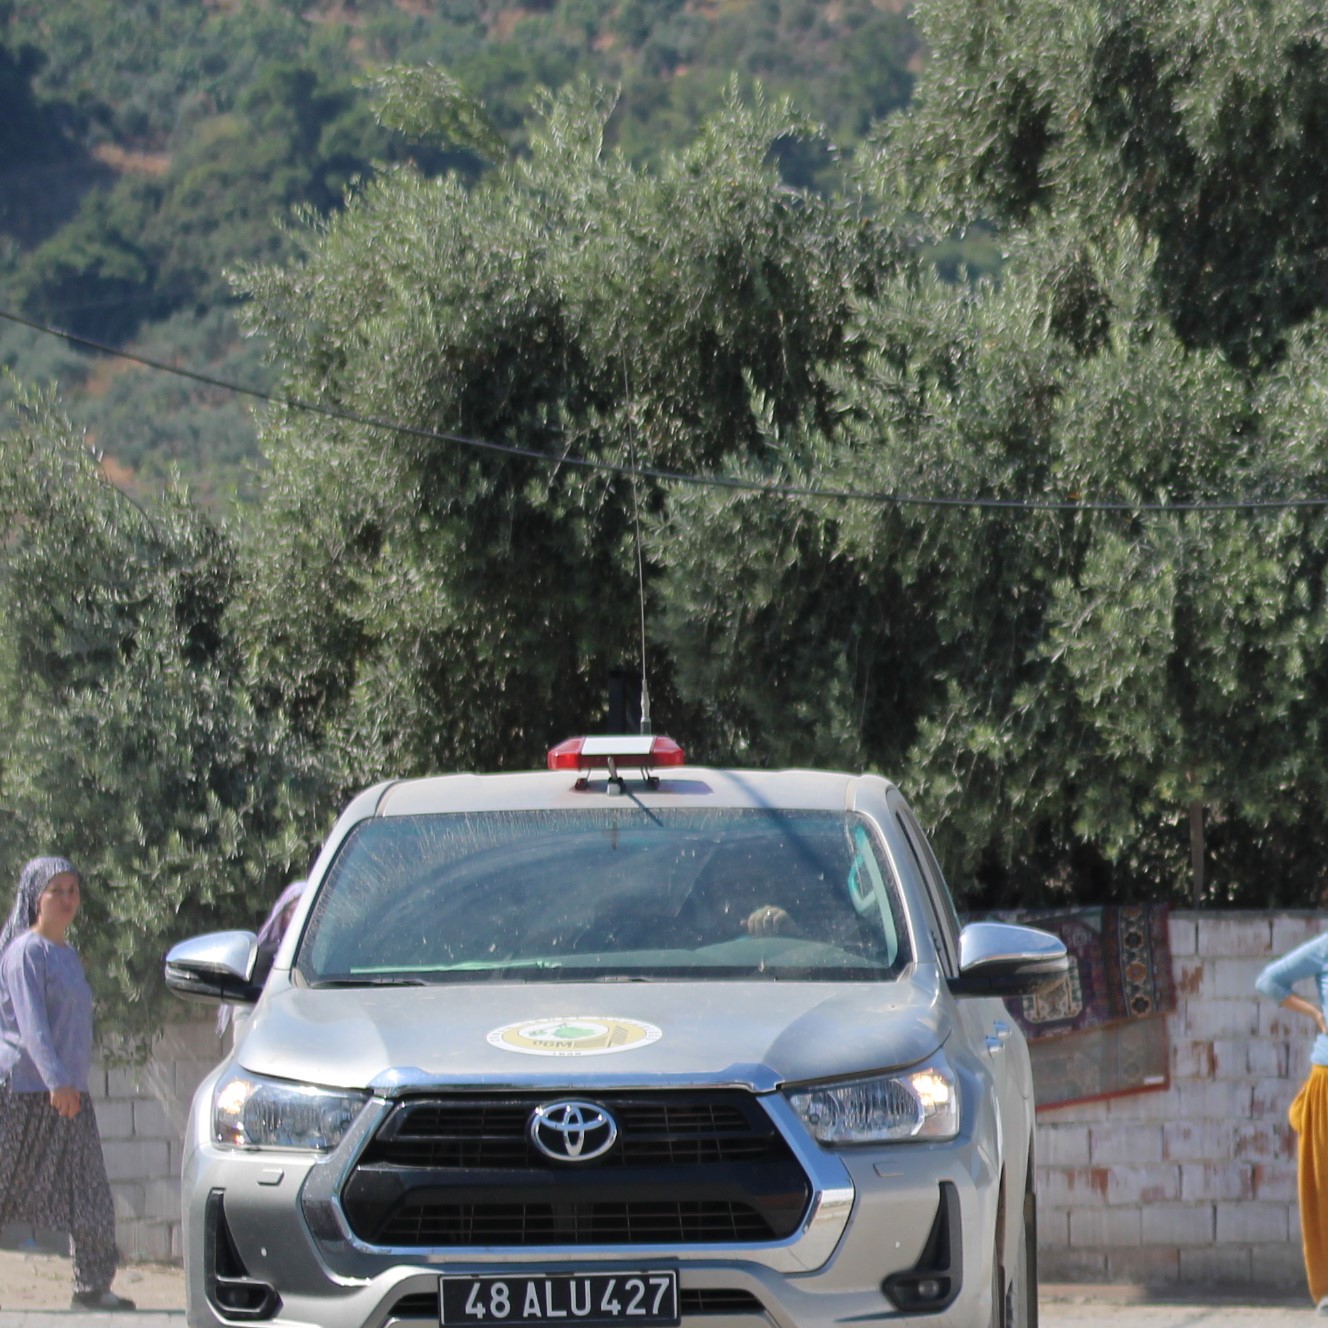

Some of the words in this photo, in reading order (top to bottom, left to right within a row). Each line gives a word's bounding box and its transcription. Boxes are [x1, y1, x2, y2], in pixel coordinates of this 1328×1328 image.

[465, 1281, 511, 1319] 48
[522, 1280, 592, 1317] ALU
[600, 1277, 670, 1316] 427
